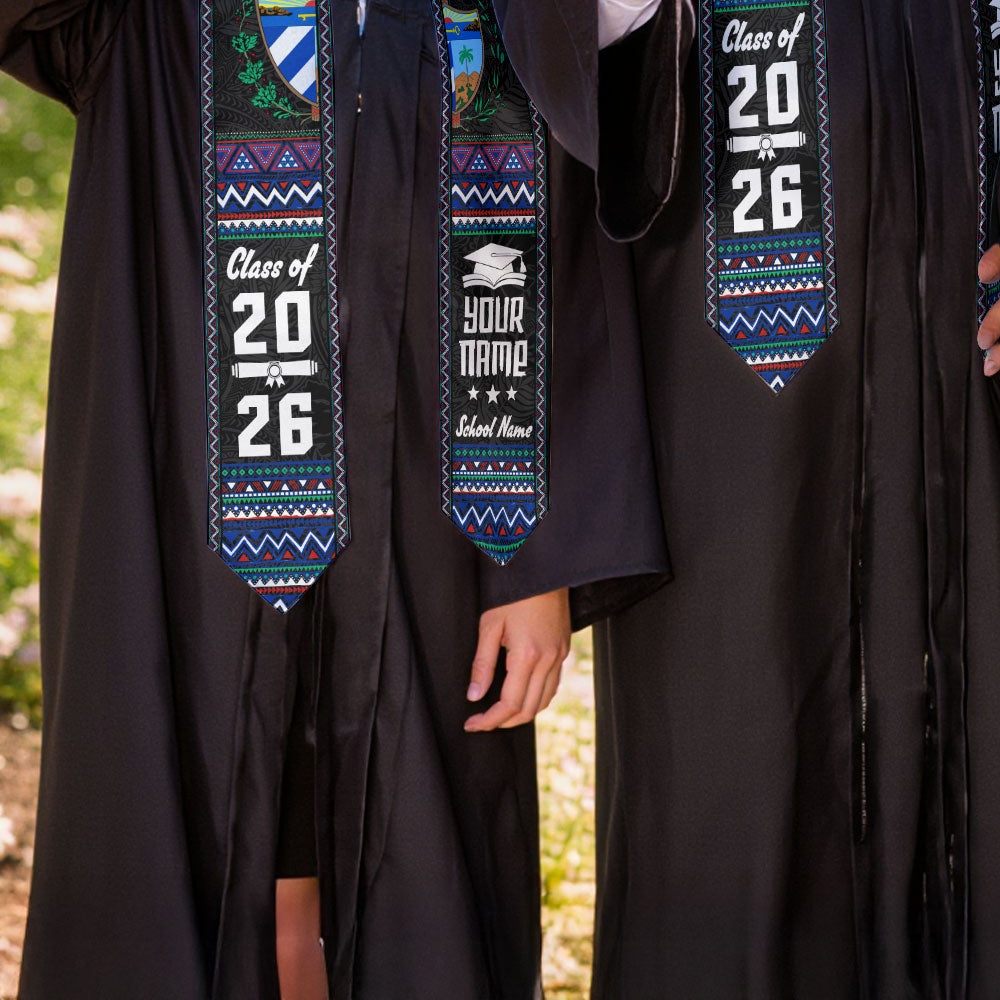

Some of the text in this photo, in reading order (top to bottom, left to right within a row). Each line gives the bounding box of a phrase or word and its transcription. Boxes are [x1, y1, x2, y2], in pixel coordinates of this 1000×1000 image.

[722, 12, 806, 57] Class of
[727, 61, 800, 129] 20
[732, 164, 803, 233] 26
[226, 243, 320, 287] Class of
[232, 290, 312, 355] 20
[464, 296, 524, 334] YOUR
[459, 339, 528, 377] NAME
[237, 392, 314, 458] 26
[455, 414, 533, 438] School Name
